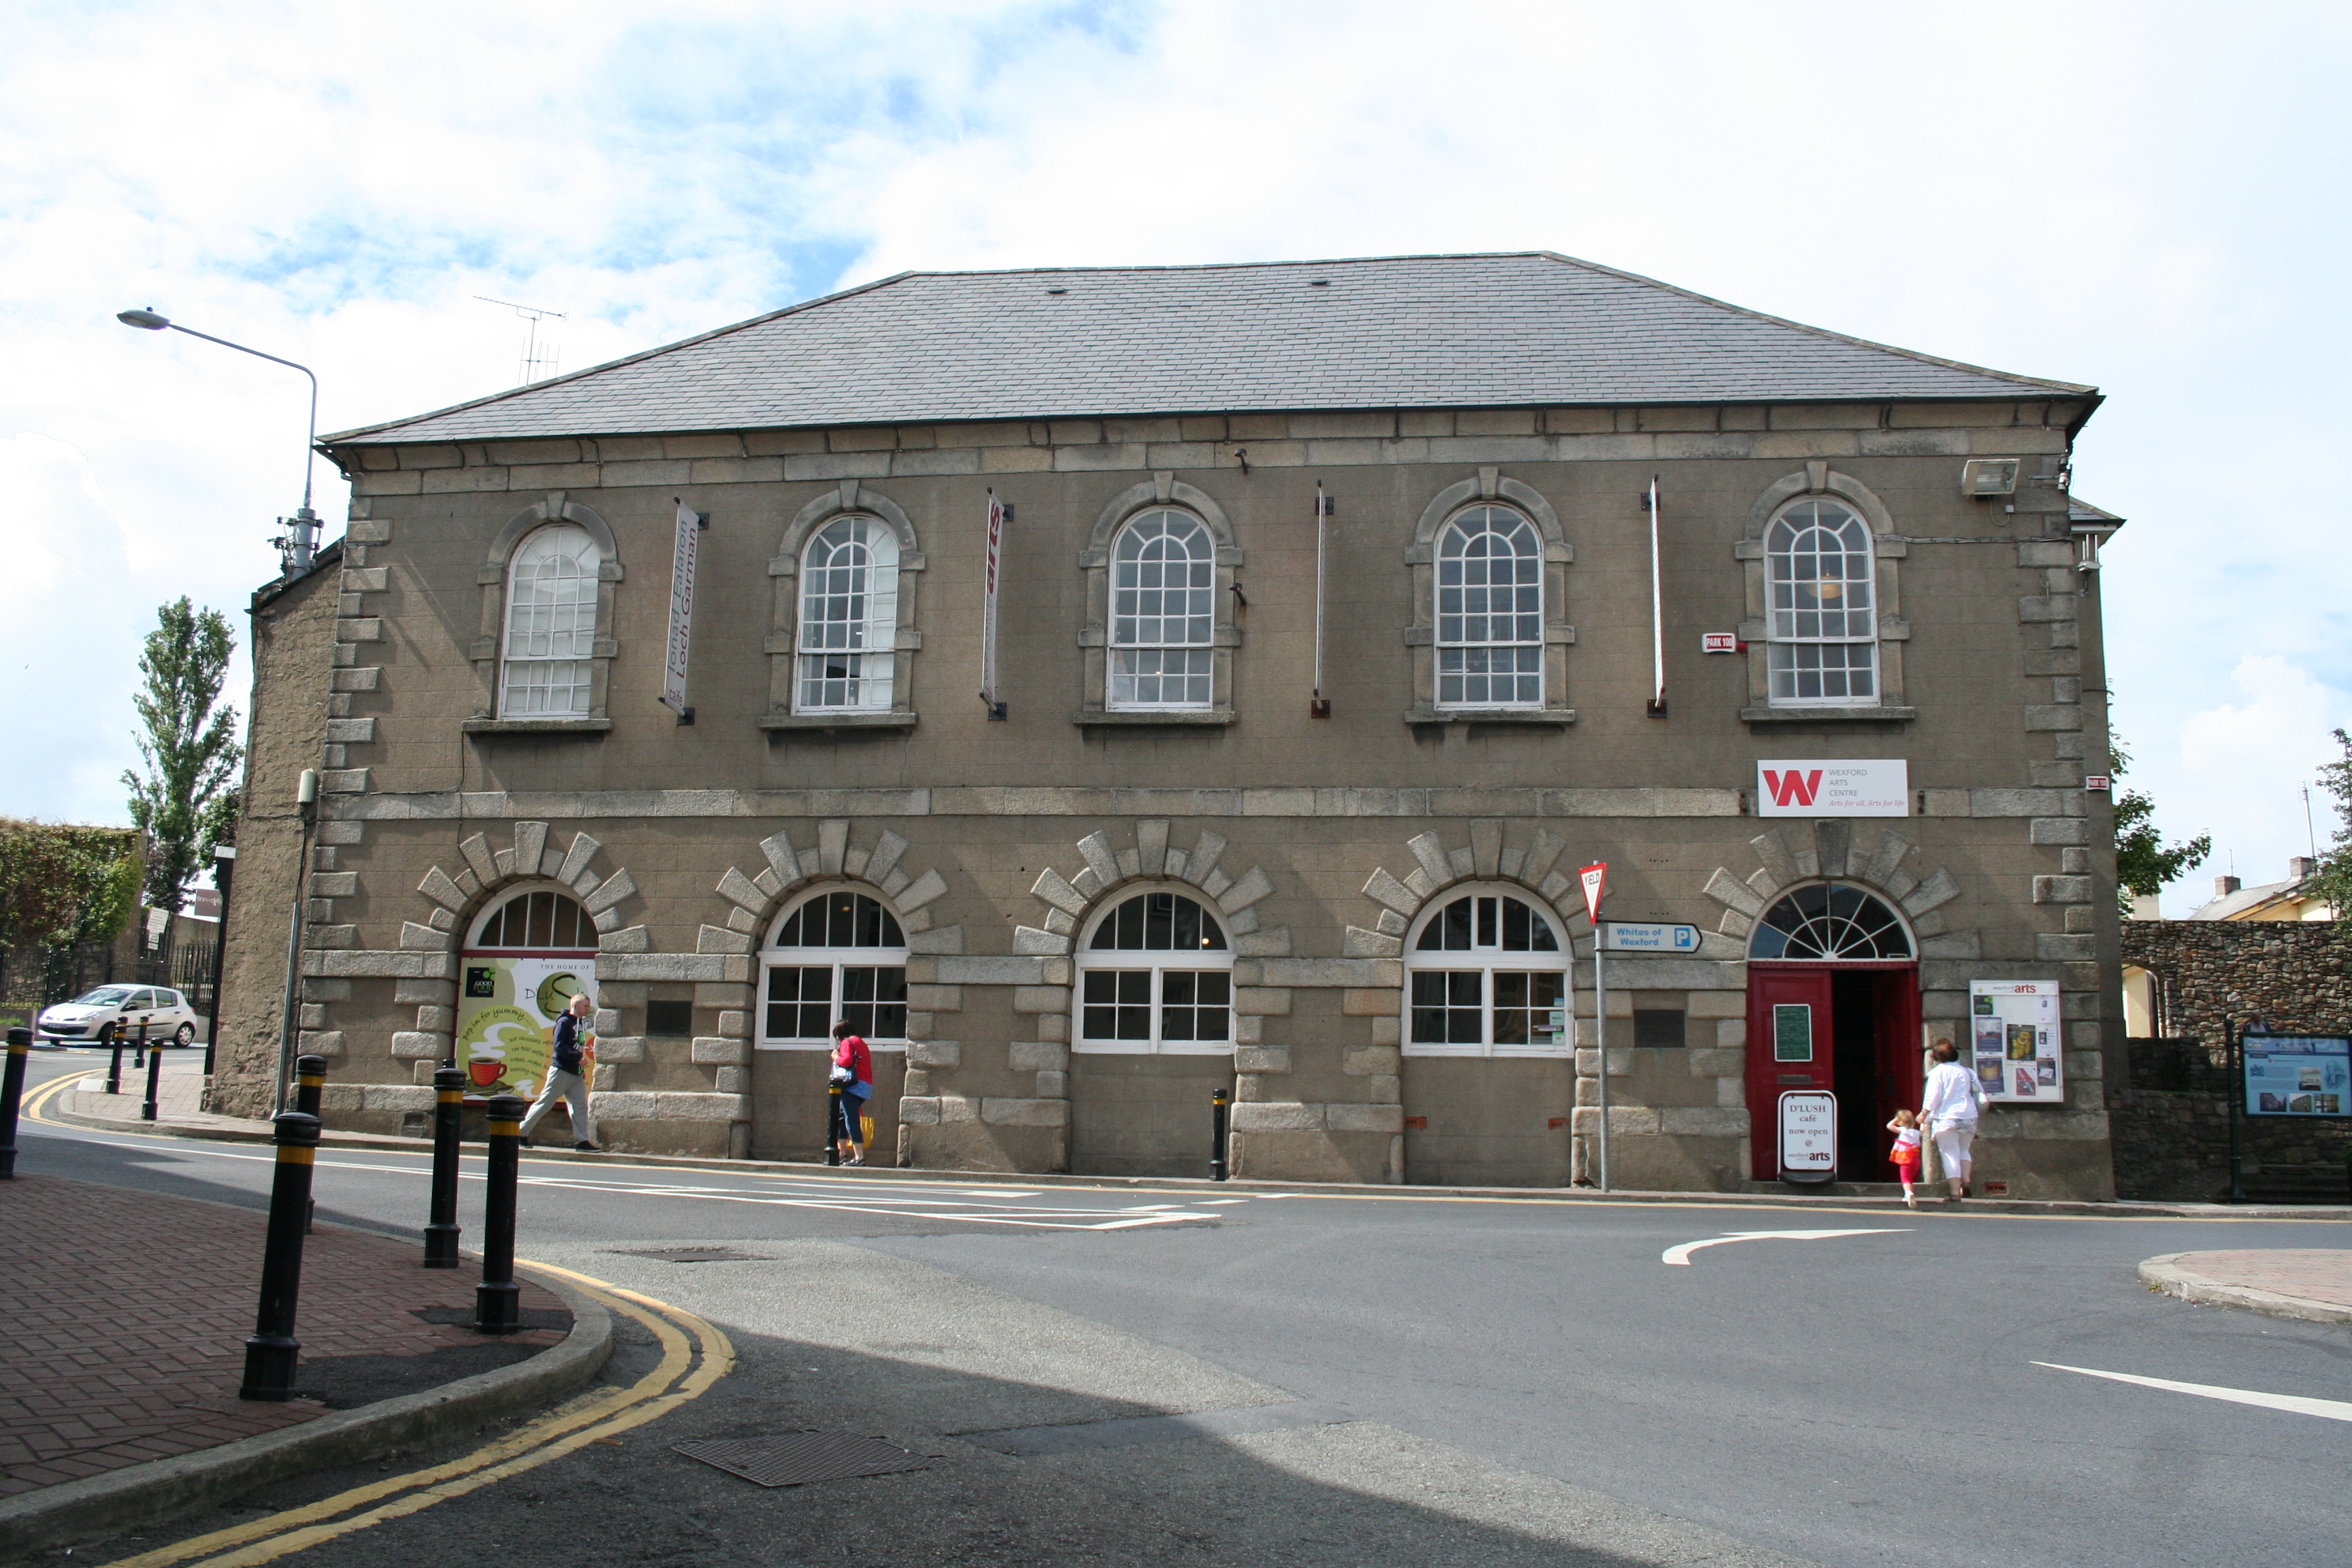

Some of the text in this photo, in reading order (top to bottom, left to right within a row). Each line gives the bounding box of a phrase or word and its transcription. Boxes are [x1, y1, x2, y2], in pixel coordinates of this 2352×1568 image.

[676, 527, 696, 679] Loch Garman
[1706, 637, 1722, 647] PARK
[1844, 800, 1855, 808] for
[1882, 800, 1893, 808] for
[1894, 800, 1905, 808] life
[1584, 872, 1600, 886] YIELD
[2014, 984, 2036, 994] arts
[463, 1027, 474, 1041] pop
[480, 1011, 491, 1022] for
[1809, 1152, 1830, 1161] arts
